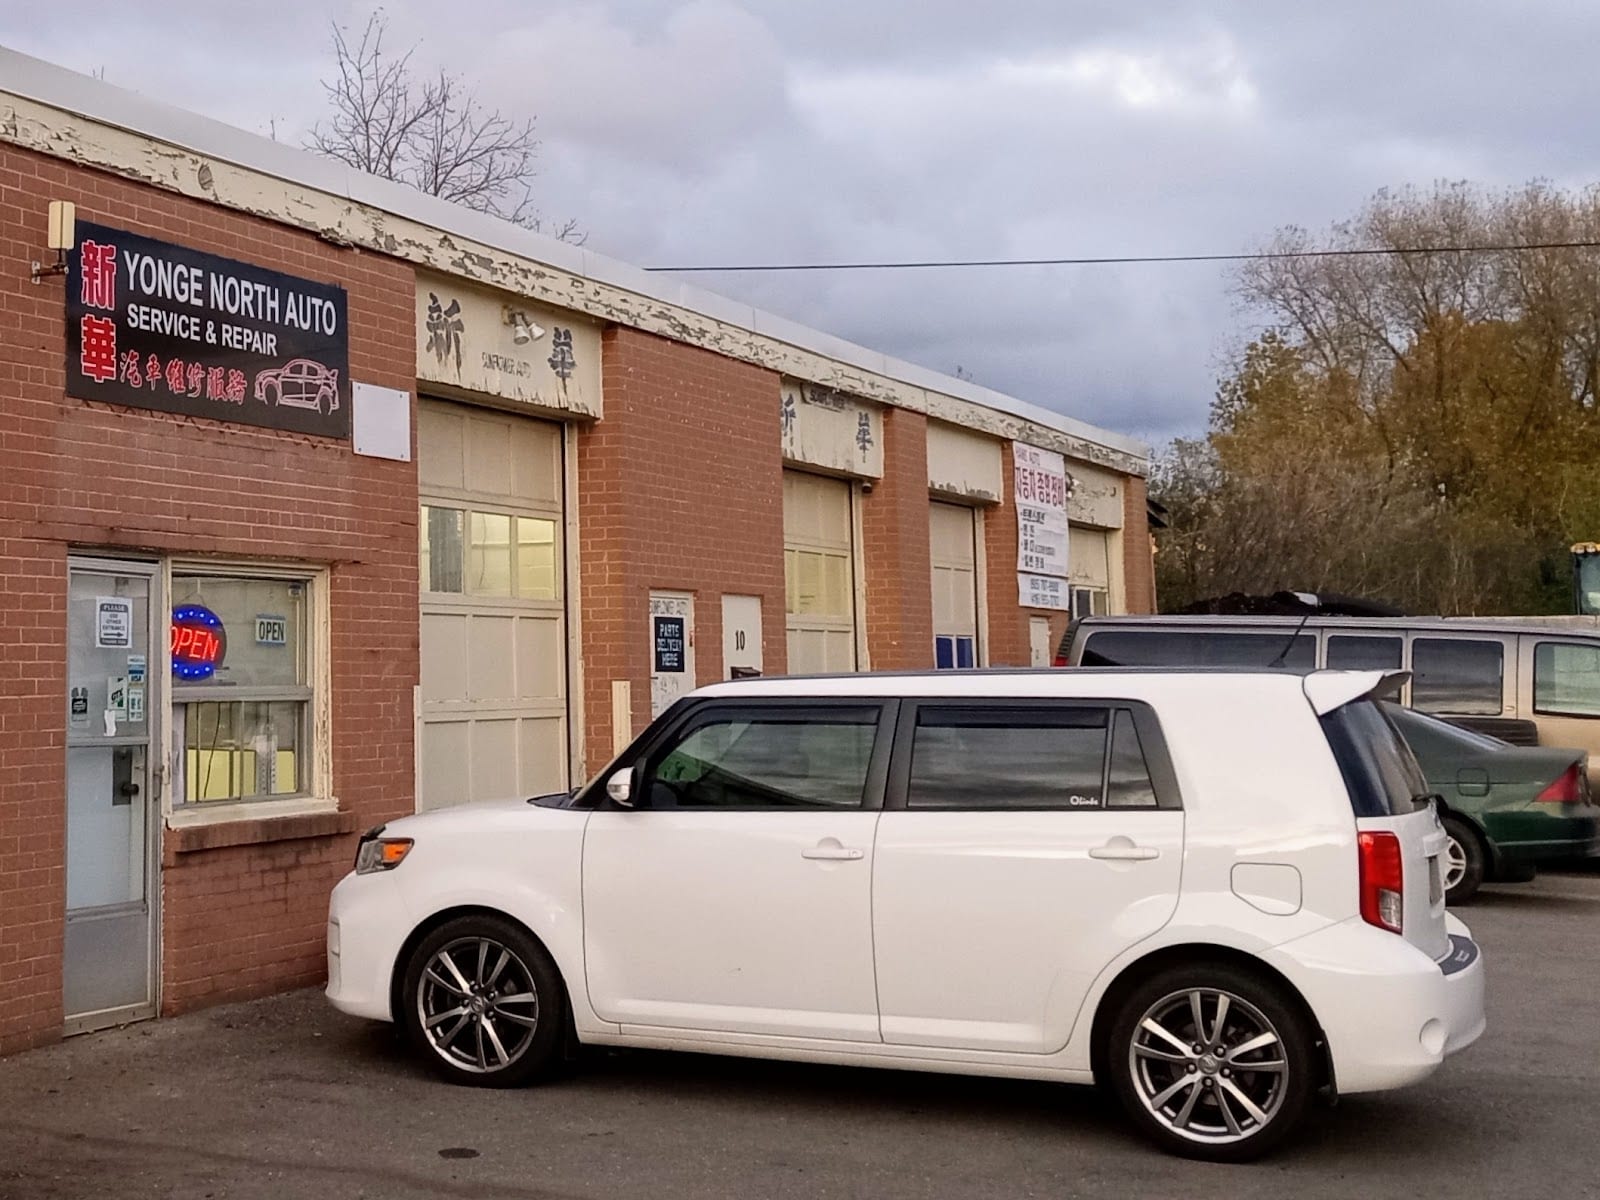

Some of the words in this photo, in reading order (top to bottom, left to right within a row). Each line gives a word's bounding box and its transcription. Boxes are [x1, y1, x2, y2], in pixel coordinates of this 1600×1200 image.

[123, 250, 203, 307] YONGE
[209, 272, 280, 324] NORTH
[284, 291, 337, 336] AUTO
[81, 240, 116, 383] 新華
[127, 303, 201, 341] SERVICE
[205, 320, 217, 345] &
[221, 323, 278, 357] REPAIR
[120, 350, 247, 404] 汽車維修服務
[169, 625, 219, 661] OPEN
[259, 621, 285, 642] OPEN
[659, 624, 680, 638] PARTS
[735, 630, 746, 651] 10
[657, 638, 682, 653] DELIVERY
[661, 653, 679, 667] HERE
